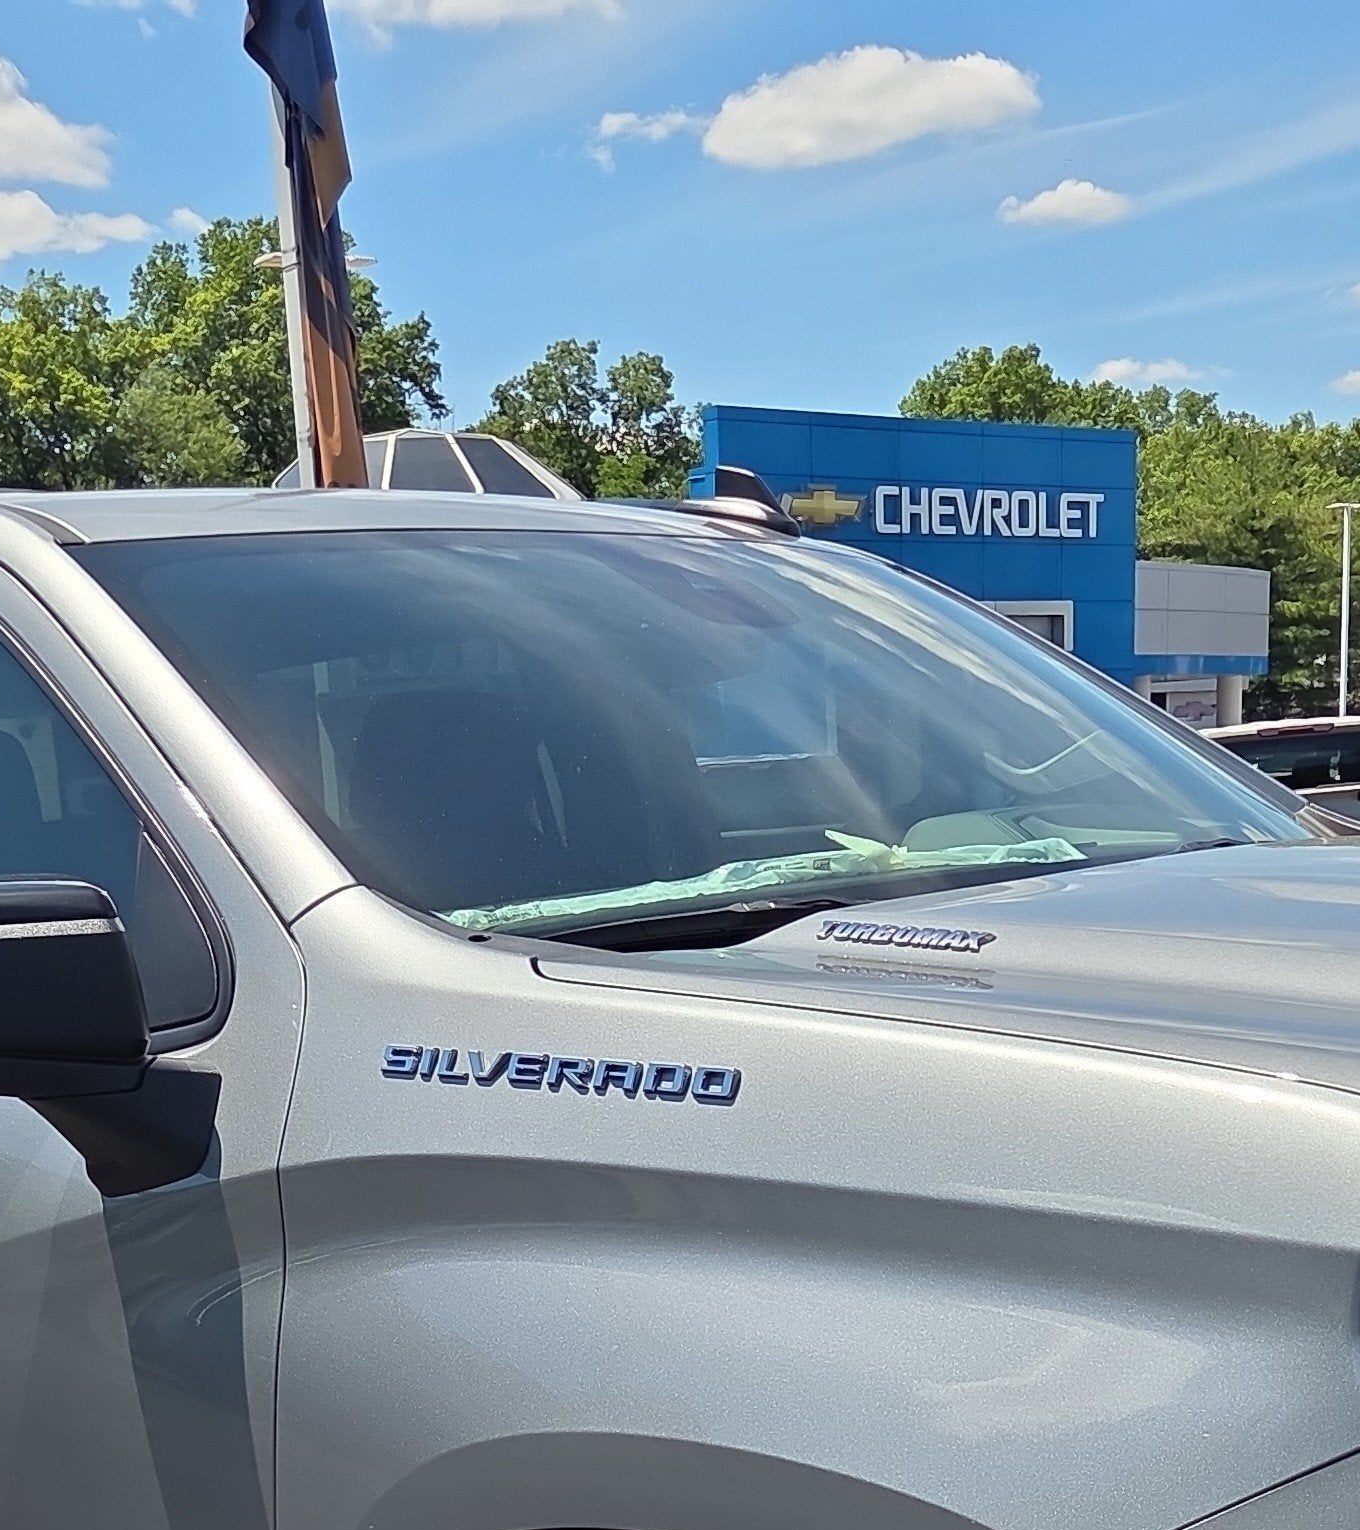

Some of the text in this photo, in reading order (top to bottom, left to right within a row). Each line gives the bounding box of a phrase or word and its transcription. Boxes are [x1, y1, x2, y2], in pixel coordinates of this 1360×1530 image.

[875, 485, 1105, 539] CHEVROLET
[816, 920, 997, 953] TURBOMAX
[381, 1044, 741, 1106] SILVERADO
